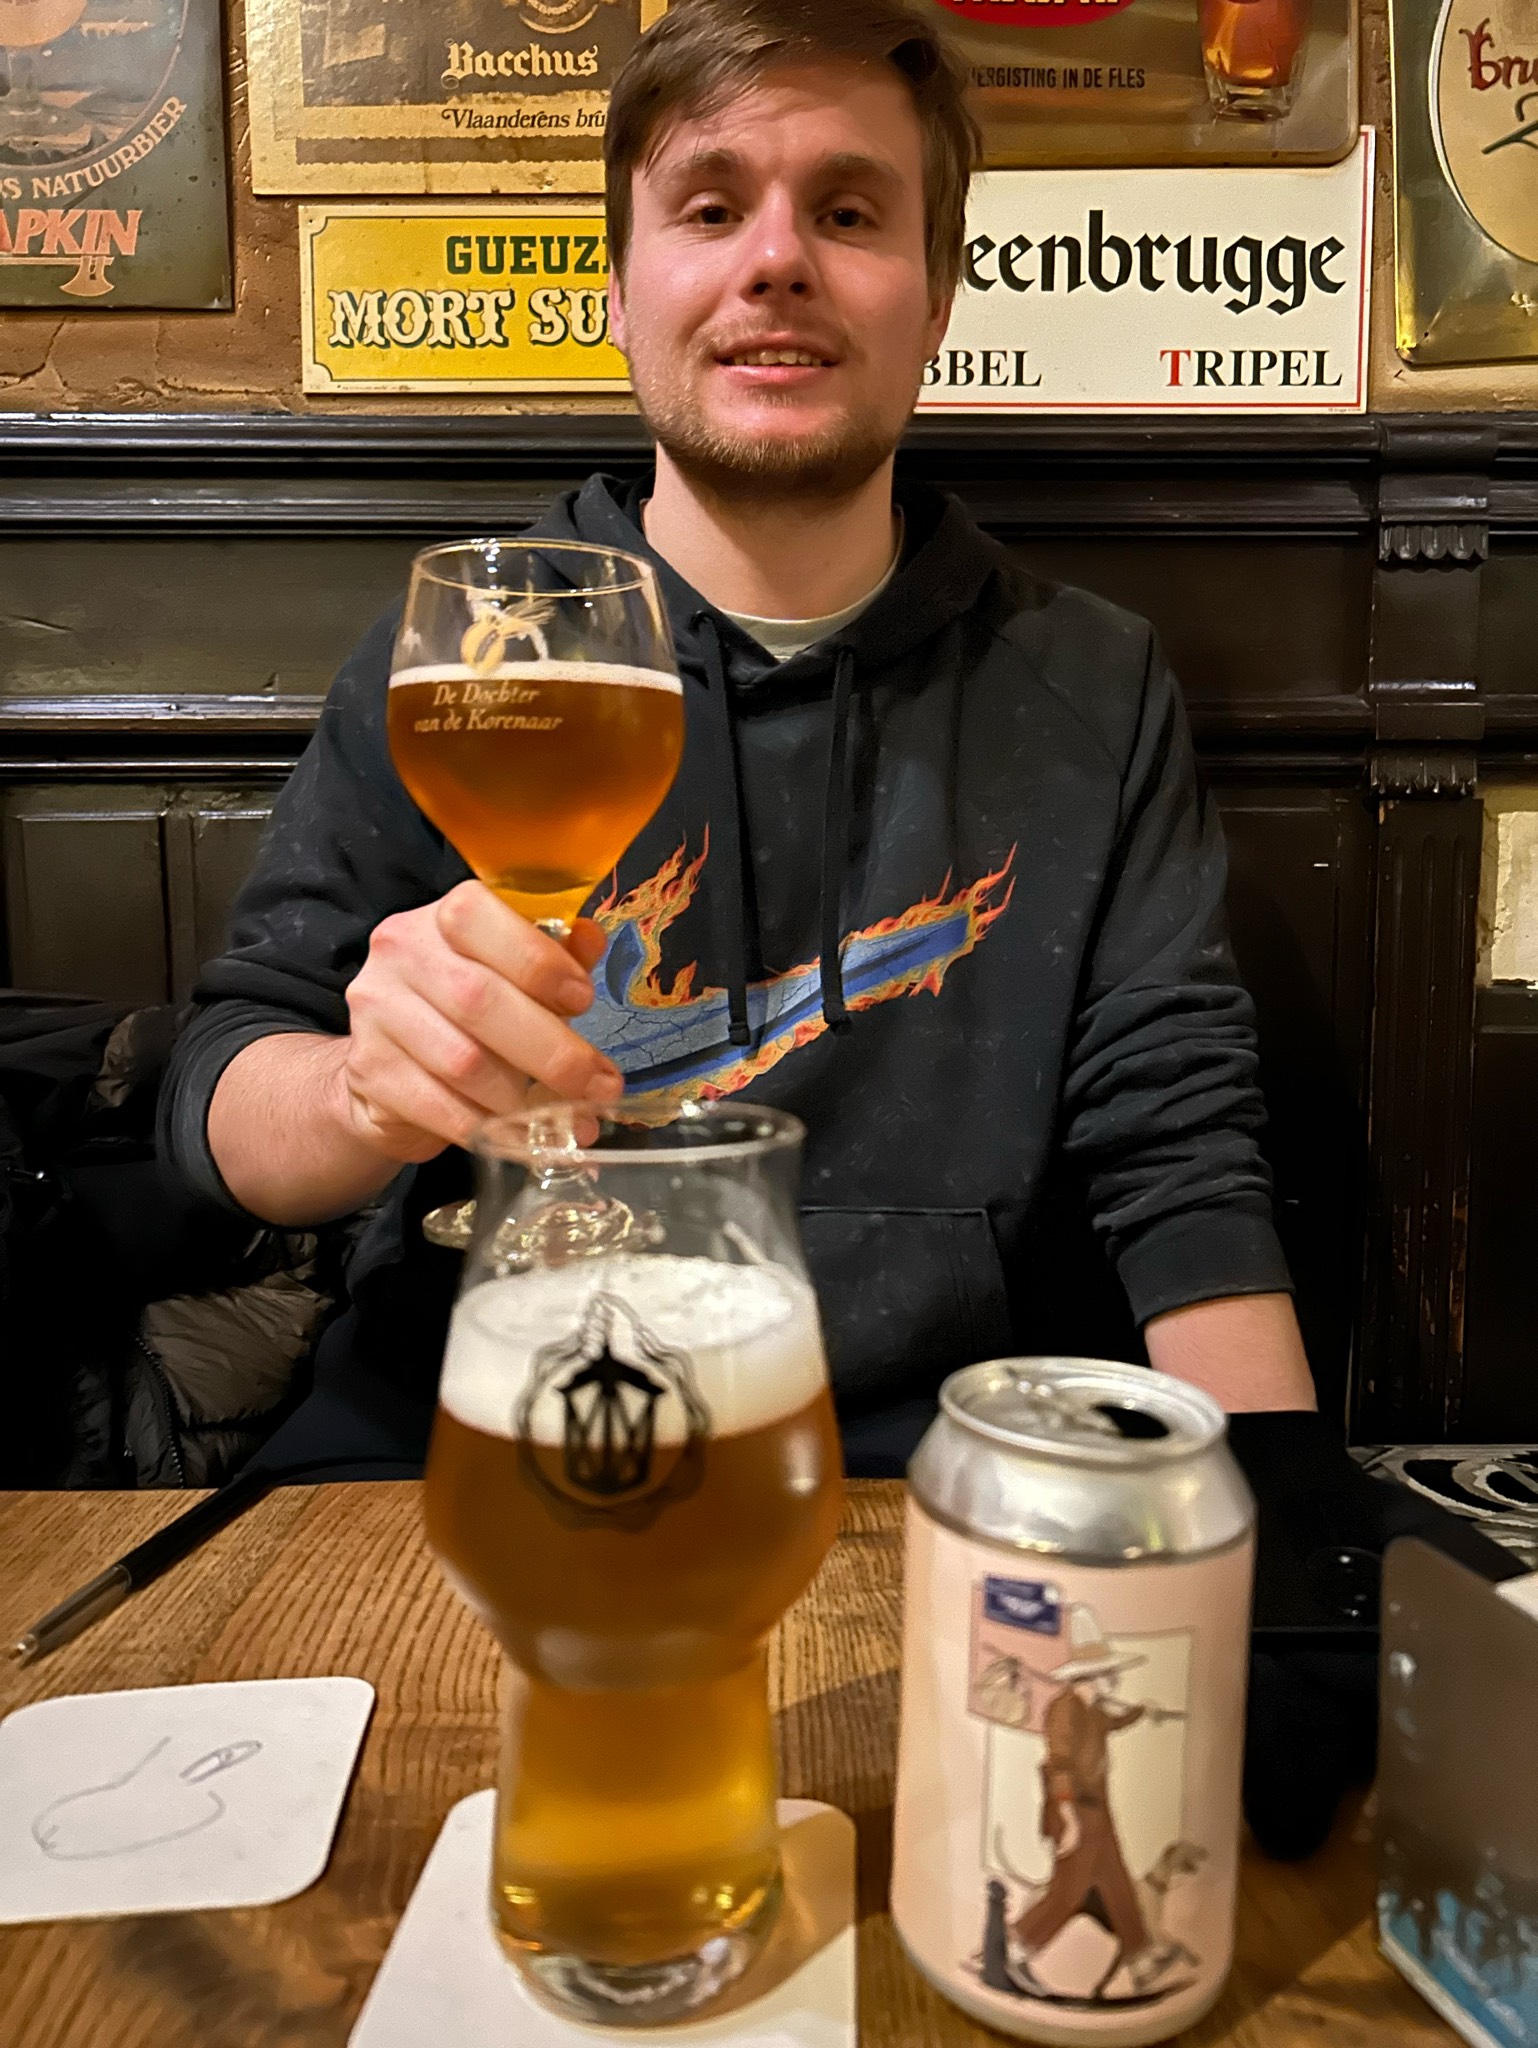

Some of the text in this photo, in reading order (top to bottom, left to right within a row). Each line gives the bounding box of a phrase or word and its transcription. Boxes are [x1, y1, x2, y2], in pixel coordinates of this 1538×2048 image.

[440, 38, 599, 90] Bacchus
[1063, 67, 1078, 88] IN
[1083, 67, 1102, 88] DE
[1108, 67, 1146, 88] FLES
[441, 108, 570, 129] Vlaanderens
[32, 96, 188, 199] NATUURBIER
[446, 235, 610, 275] GUEUZ
[328, 287, 616, 349] MORT SU
[1159, 349, 1343, 387] TRIPEL
[433, 682, 456, 707] De
[414, 708, 565, 733] van de Korenaar
